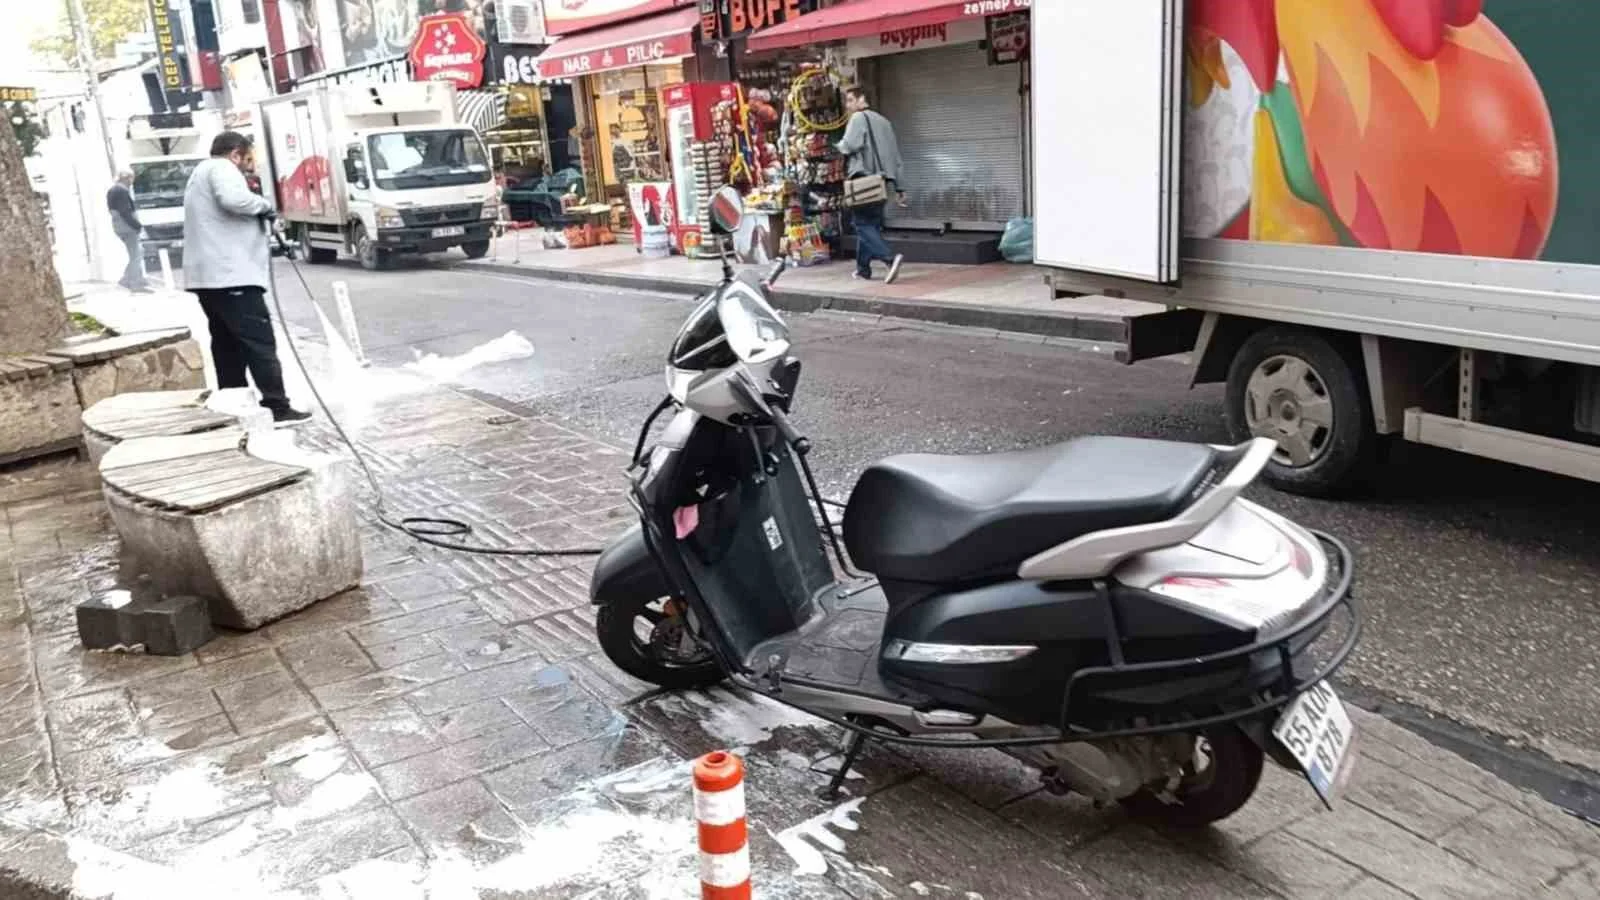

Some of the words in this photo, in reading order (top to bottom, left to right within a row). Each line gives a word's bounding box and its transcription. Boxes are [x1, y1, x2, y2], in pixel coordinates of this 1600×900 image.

[163, 57, 180, 86] CEP
[562, 55, 592, 74] NAR
[1284, 715, 1312, 757] 55
[1315, 718, 1343, 773] 878
